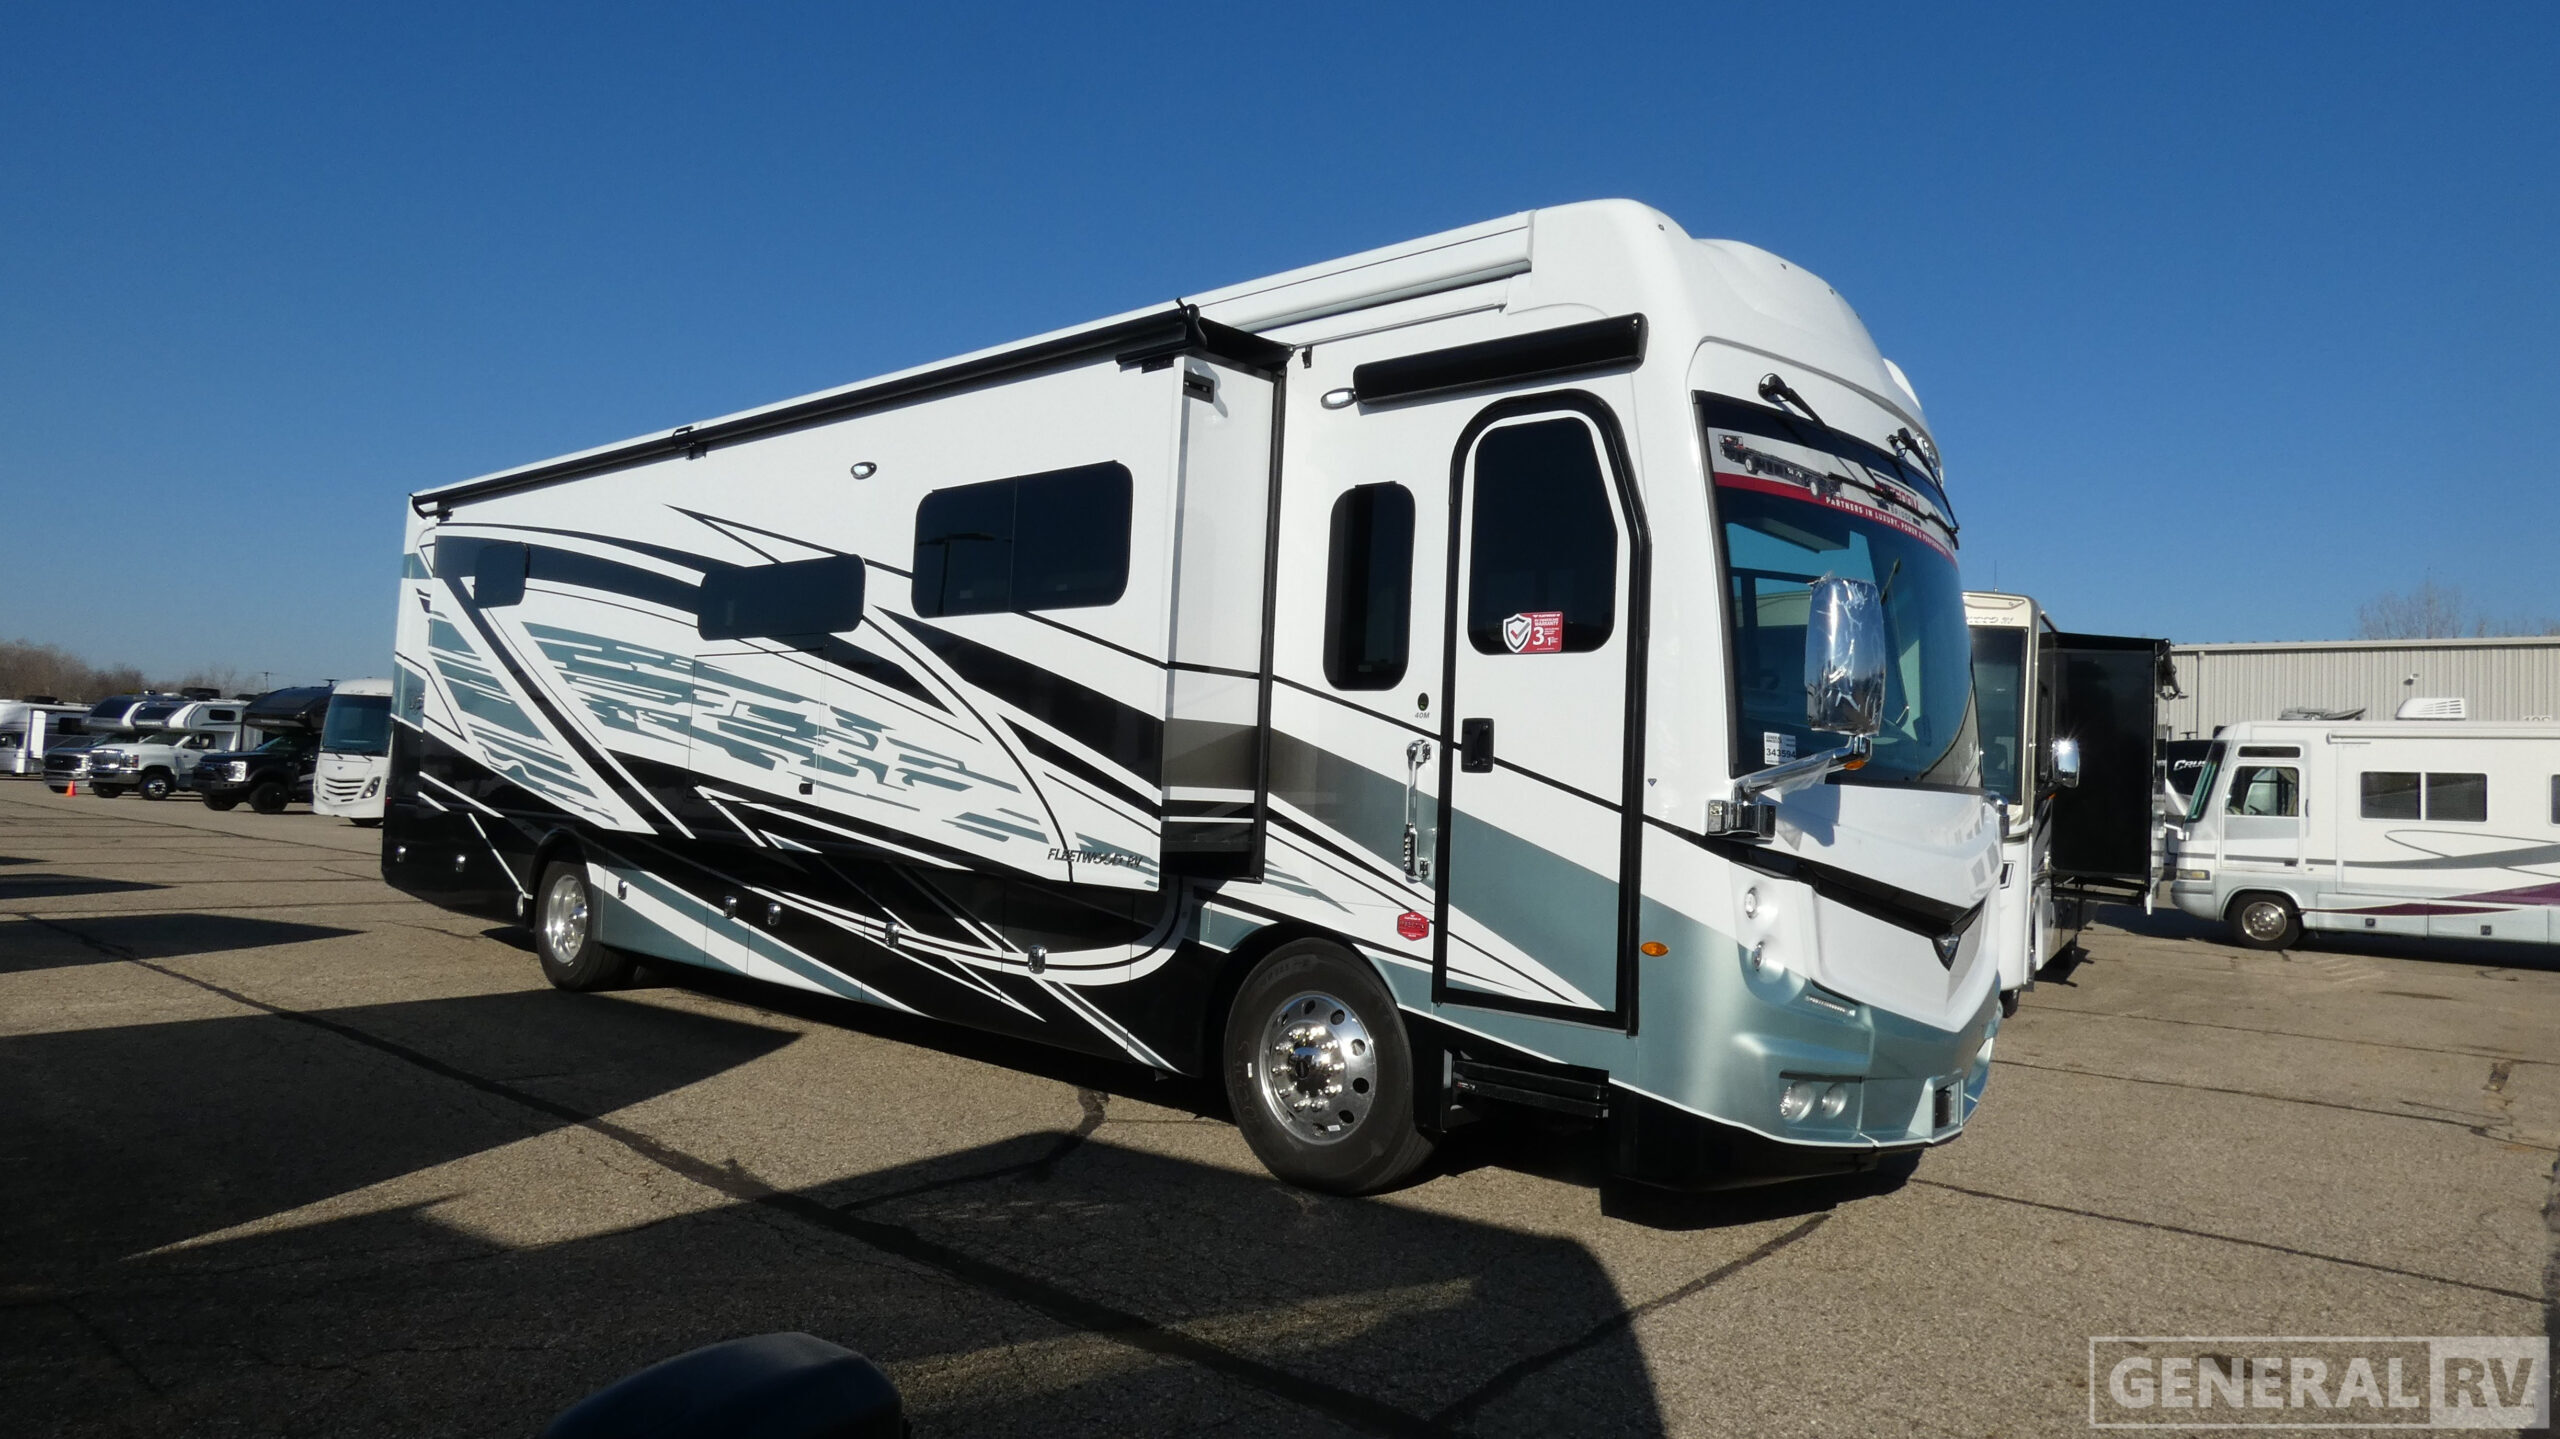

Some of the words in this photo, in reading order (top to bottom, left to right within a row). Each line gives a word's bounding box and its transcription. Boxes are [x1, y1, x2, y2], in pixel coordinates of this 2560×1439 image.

[1825, 496, 1863, 514] PARTNERS
[1532, 626, 1545, 646] 3
[1766, 748, 1796, 758] 343594
[1047, 848, 1123, 866] FLEETWOOD
